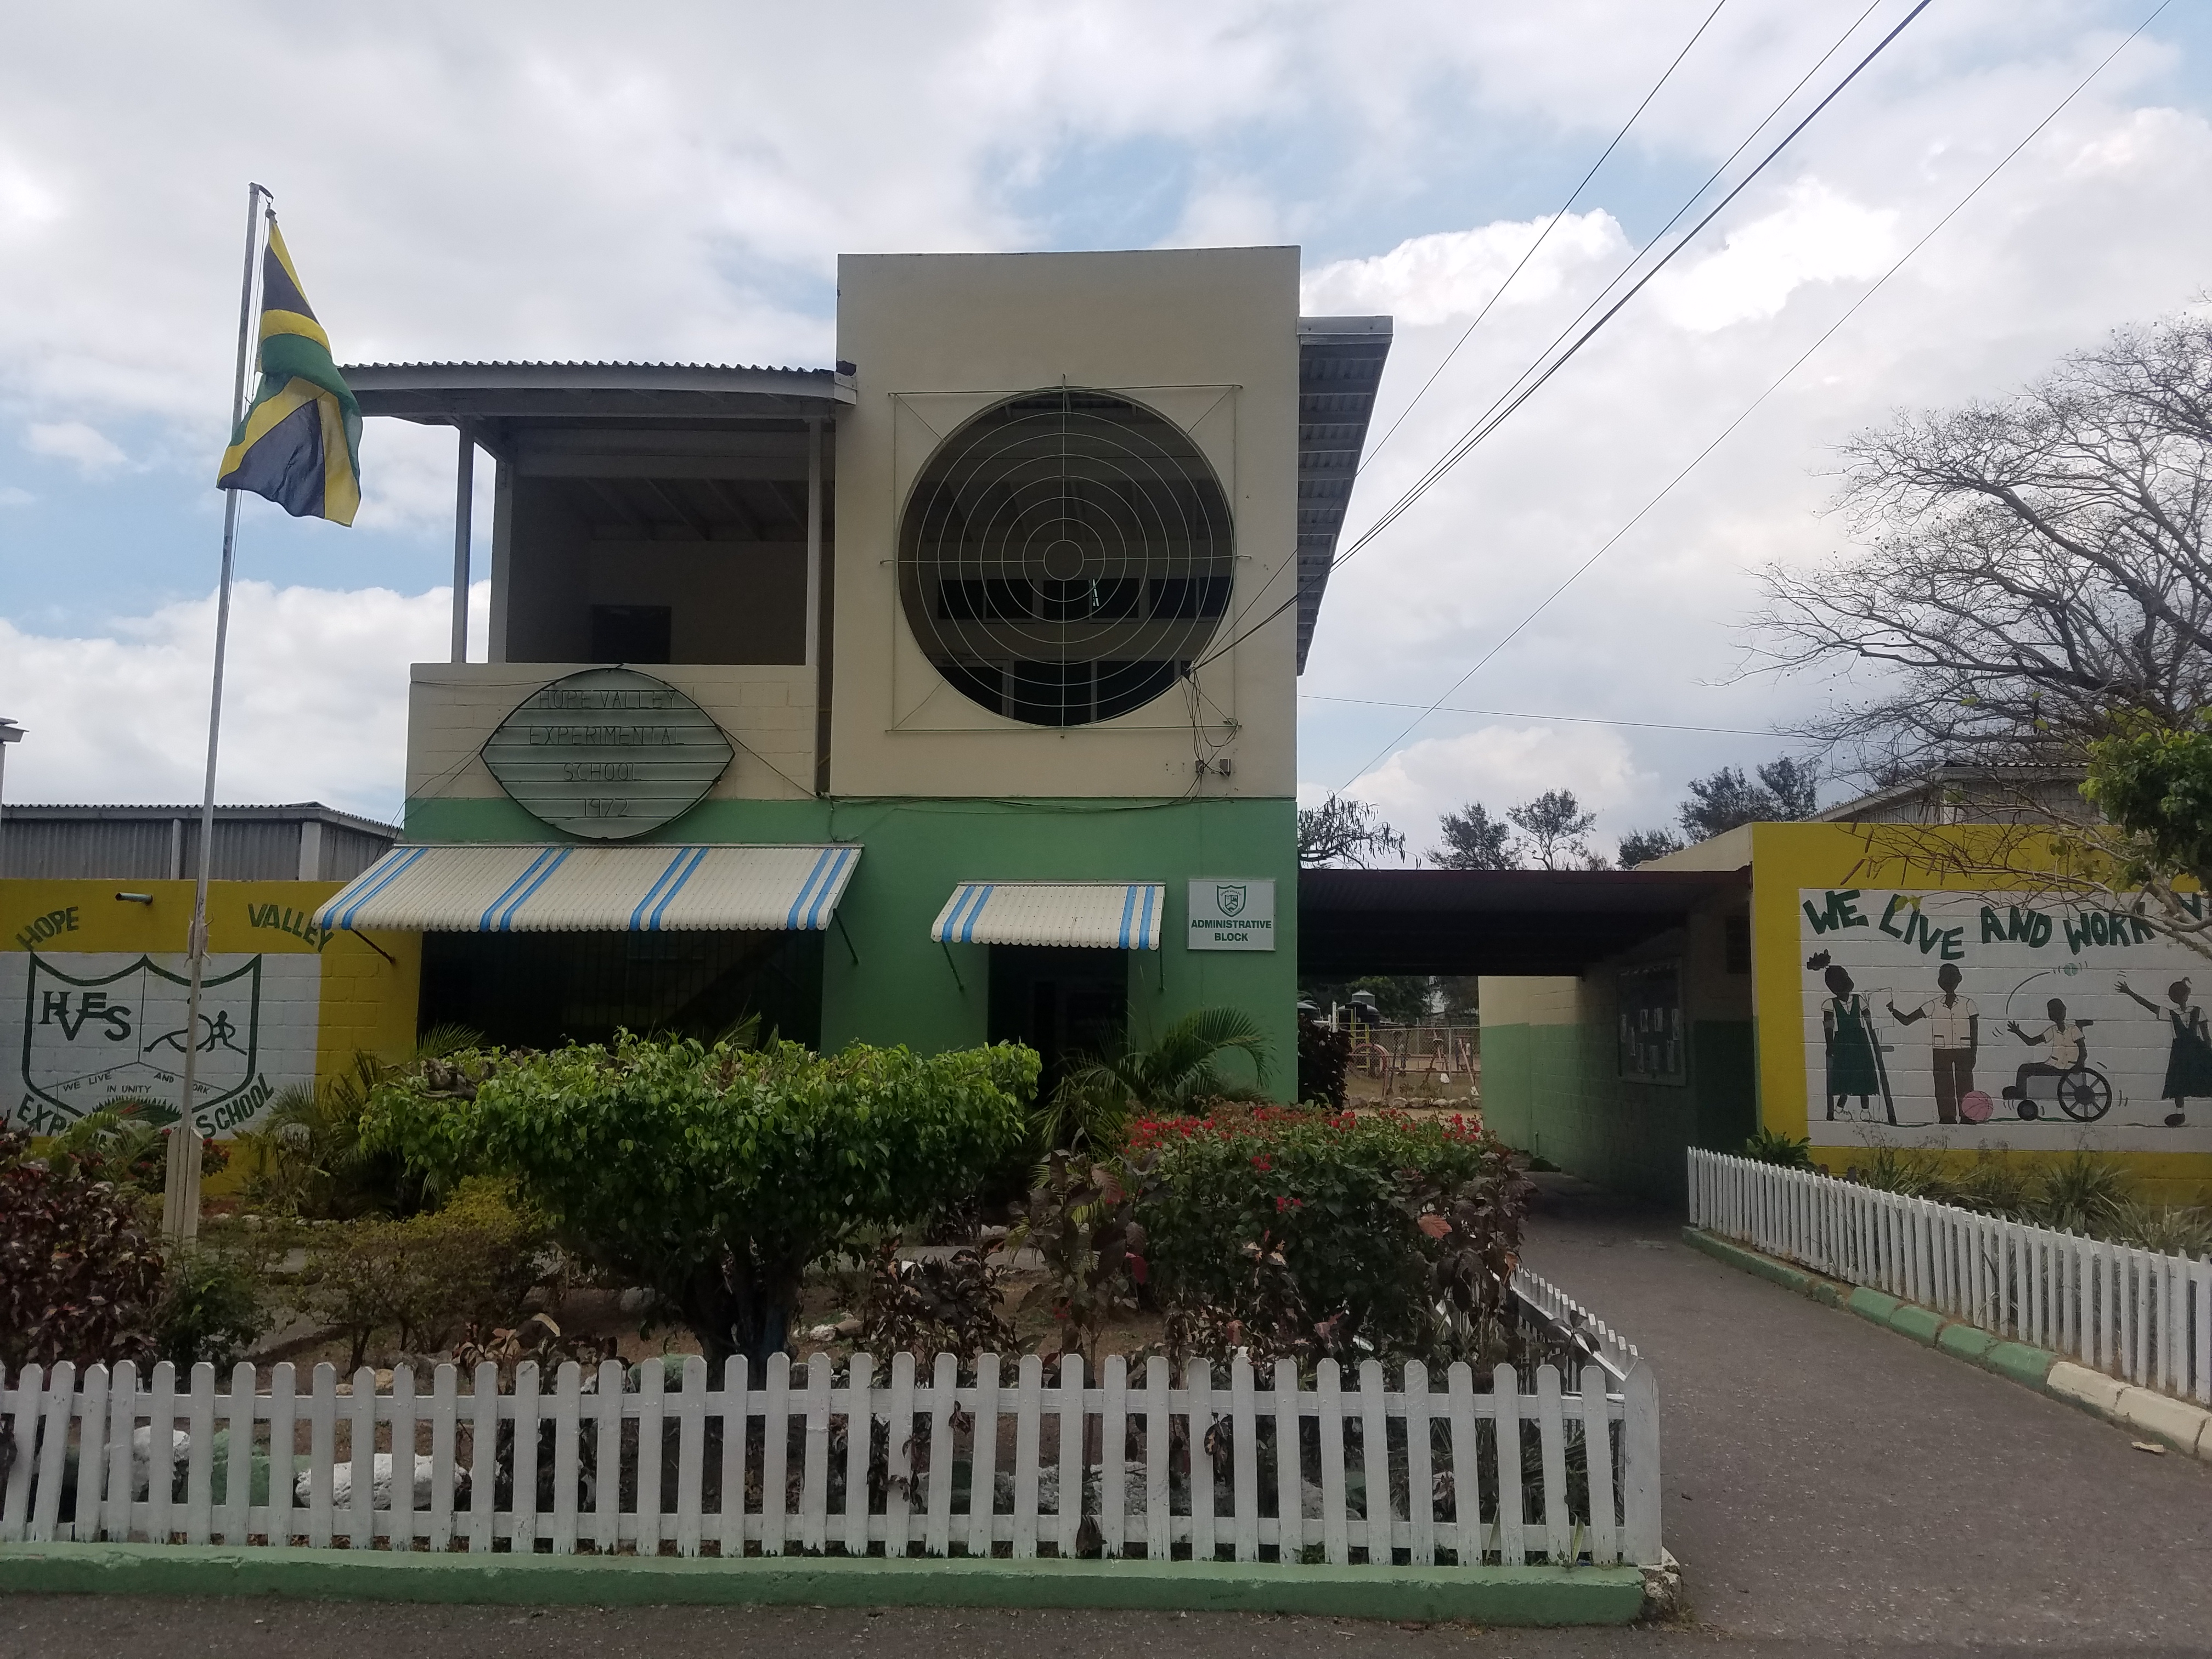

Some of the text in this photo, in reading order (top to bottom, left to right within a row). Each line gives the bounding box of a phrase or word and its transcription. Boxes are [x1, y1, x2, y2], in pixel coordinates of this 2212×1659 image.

[539, 690, 677, 708] HOPE VALLEY
[529, 726, 685, 746] EXPERIMENTAL
[564, 763, 642, 781] SCHOOL
[584, 799, 629, 817] 1972
[15, 903, 335, 952] HOPE VALLEY
[1191, 919, 1272, 929] ADMINISTRATIVE
[1802, 889, 1870, 935] WE
[1878, 894, 1965, 960] LIVE
[1980, 905, 2053, 949] AND
[2062, 901, 2157, 956] WORK
[1214, 933, 1249, 941] BLOCK
[63, 1071, 211, 1094] WE LIVE AND ORK
[106, 1085, 152, 1093] IN UNITY
[195, 1073, 275, 1139] SCHOOL
